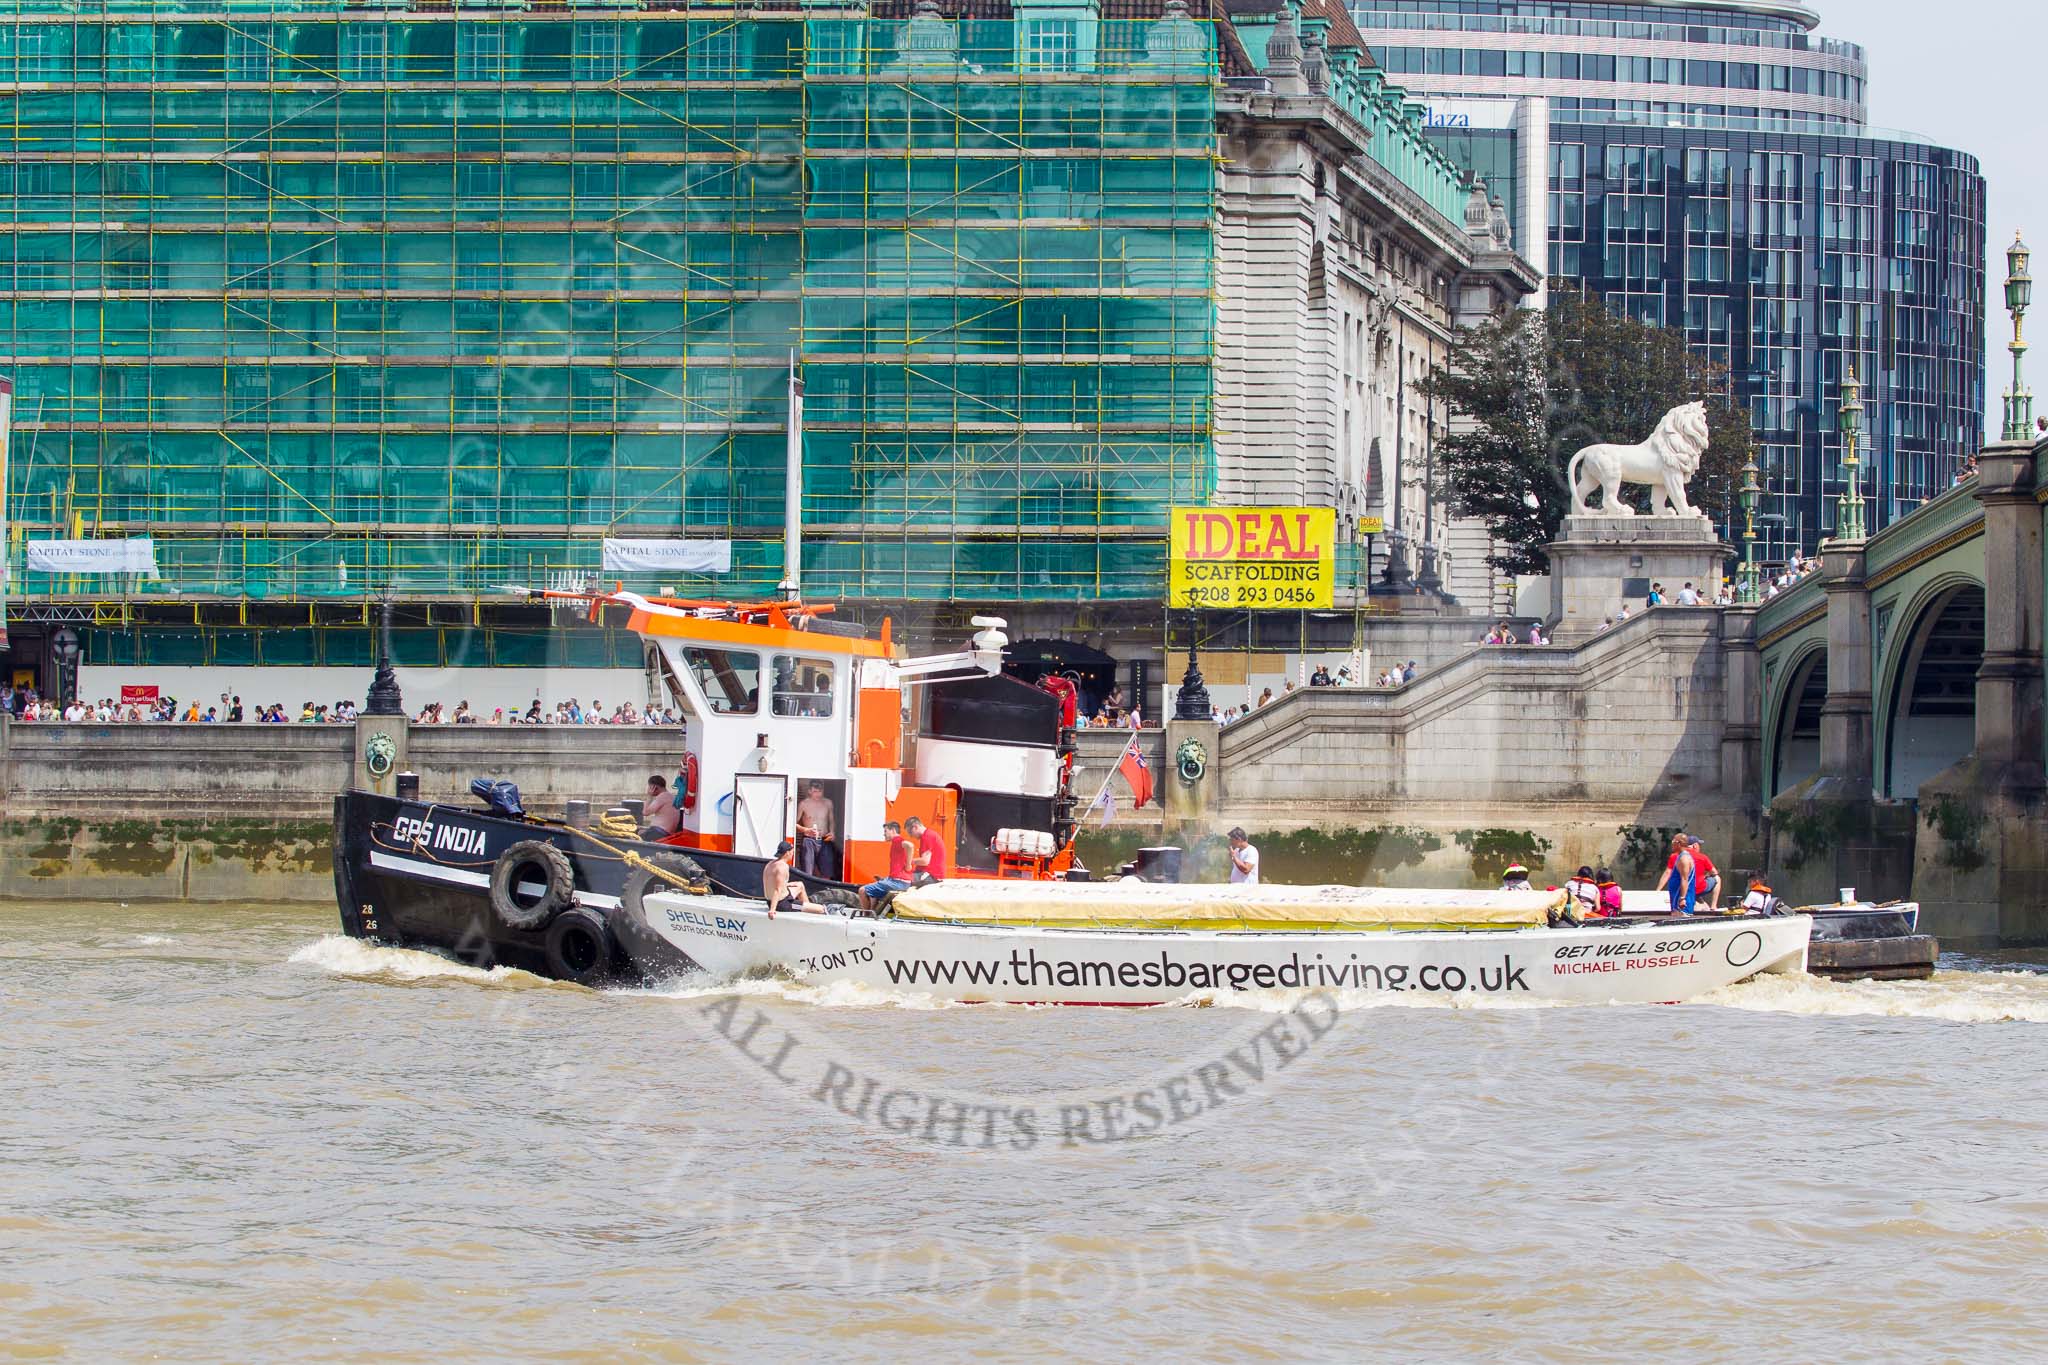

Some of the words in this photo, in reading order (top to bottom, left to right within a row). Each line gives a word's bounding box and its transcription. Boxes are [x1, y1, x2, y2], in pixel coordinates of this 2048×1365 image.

[1185, 513, 1320, 559] IDEAL
[28, 547, 73, 558] CAPITAL
[78, 547, 112, 558] STONE
[604, 547, 650, 556] CAPITAL
[655, 547, 689, 557] STONE
[1185, 565, 1320, 581] SCAFFOLDING
[1189, 587, 1230, 602] 0208
[1237, 587, 1267, 602] 293
[1274, 587, 1315, 602] 0456
[393, 816, 434, 847] GPS
[434, 825, 486, 856] INDIA
[362, 904, 373, 915] 28
[366, 919, 378, 930] 26
[666, 909, 714, 928] SHELL
[715, 916, 747, 933] BAY
[670, 923, 696, 935] SOUTH
[696, 927, 716, 937] DOCK
[1554, 944, 1593, 959] GET
[1595, 941, 1648, 957] WELL
[1654, 937, 1713, 954] SOON
[821, 952, 847, 970] ON
[1553, 960, 1621, 976] MICHAEL
[1625, 954, 1701, 970] RUSSELL
[883, 948, 1531, 992] www.thamesbargedriving.co.uk
